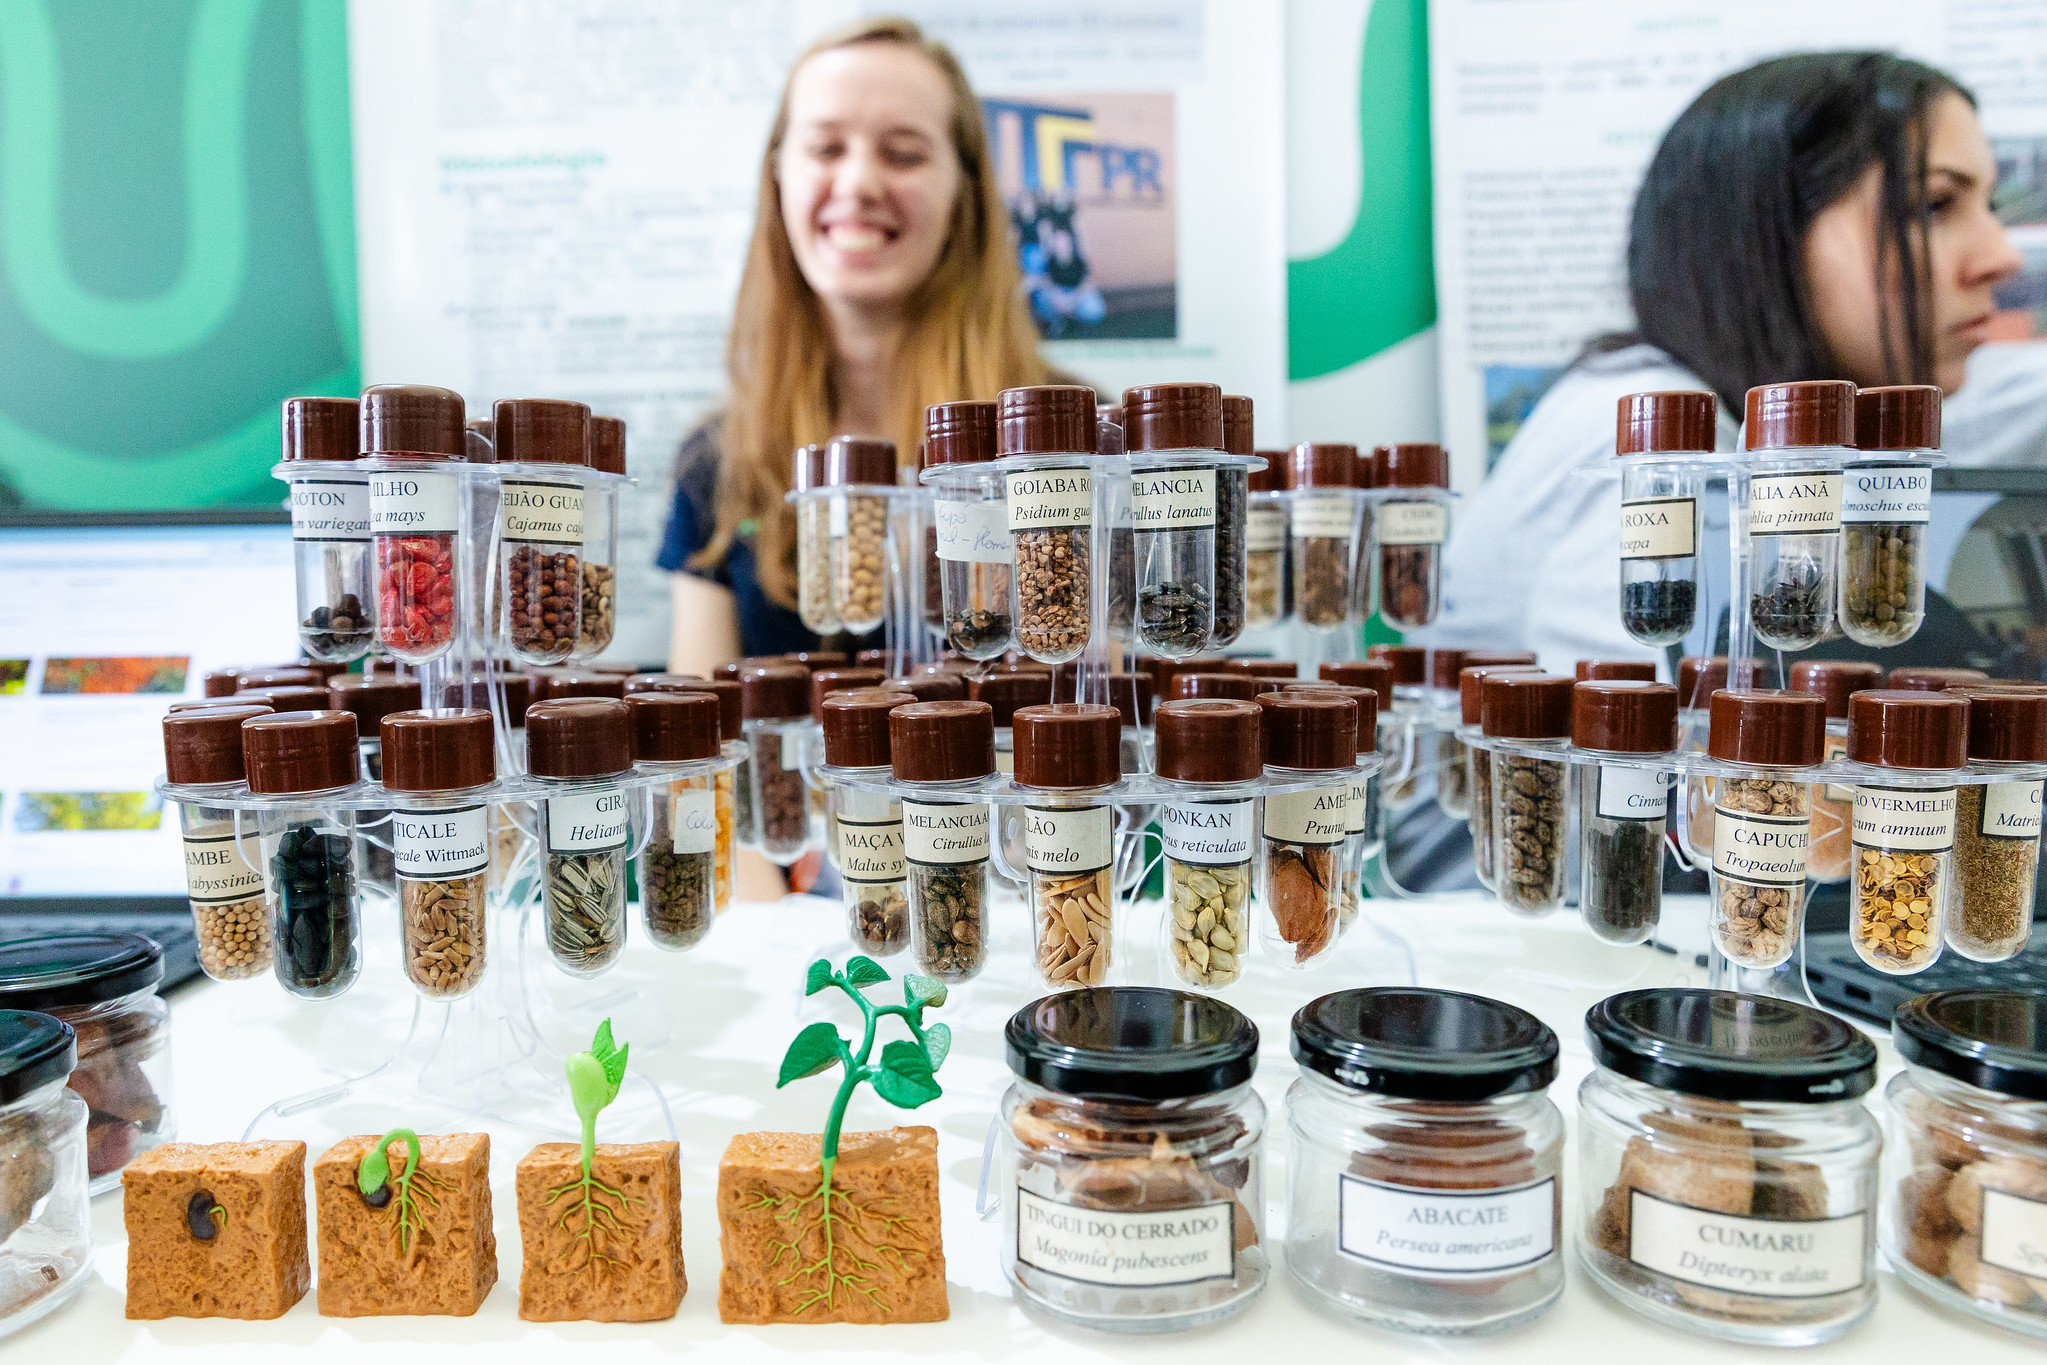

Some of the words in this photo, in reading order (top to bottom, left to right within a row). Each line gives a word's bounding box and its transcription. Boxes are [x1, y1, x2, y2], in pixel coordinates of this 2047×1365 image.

[1013, 478, 1078, 496] GOIABA
[1788, 480, 1830, 499] ANÃ
[1858, 475, 1927, 494] QUIABO
[385, 511, 426, 526] mays
[1014, 504, 1070, 521] Psidium
[1073, 506, 1092, 521] gua
[1167, 504, 1213, 520] lanatus
[1625, 511, 1670, 528] ROXA
[1775, 509, 1834, 527] pinnata
[507, 515, 563, 534] Cajanus
[1870, 796, 1955, 813] VERMELHO
[909, 813, 981, 829] MELANCIA
[1163, 804, 1232, 829] PONKAN
[1852, 814, 1876, 833] cum
[1881, 823, 1947, 837] annuum
[845, 832, 894, 851] MAÇA
[932, 835, 983, 850] Citrullus
[1181, 838, 1247, 853] reticulata
[425, 841, 486, 863] Wittmack
[1042, 847, 1080, 863] melo
[847, 856, 887, 872] Malus
[1026, 1203, 1082, 1235] TINGUI
[1088, 1221, 1117, 1239] DO
[1121, 1215, 1219, 1241] CERRADO
[1406, 1205, 1510, 1227] ABACATE
[1376, 1228, 1441, 1255] Persea
[1445, 1233, 1534, 1255] americana
[1698, 1223, 1813, 1253] CUMARU
[1035, 1235, 1108, 1267] Magonia
[1112, 1248, 1210, 1273] pubescens
[1678, 1249, 1772, 1284] Dipteryx
